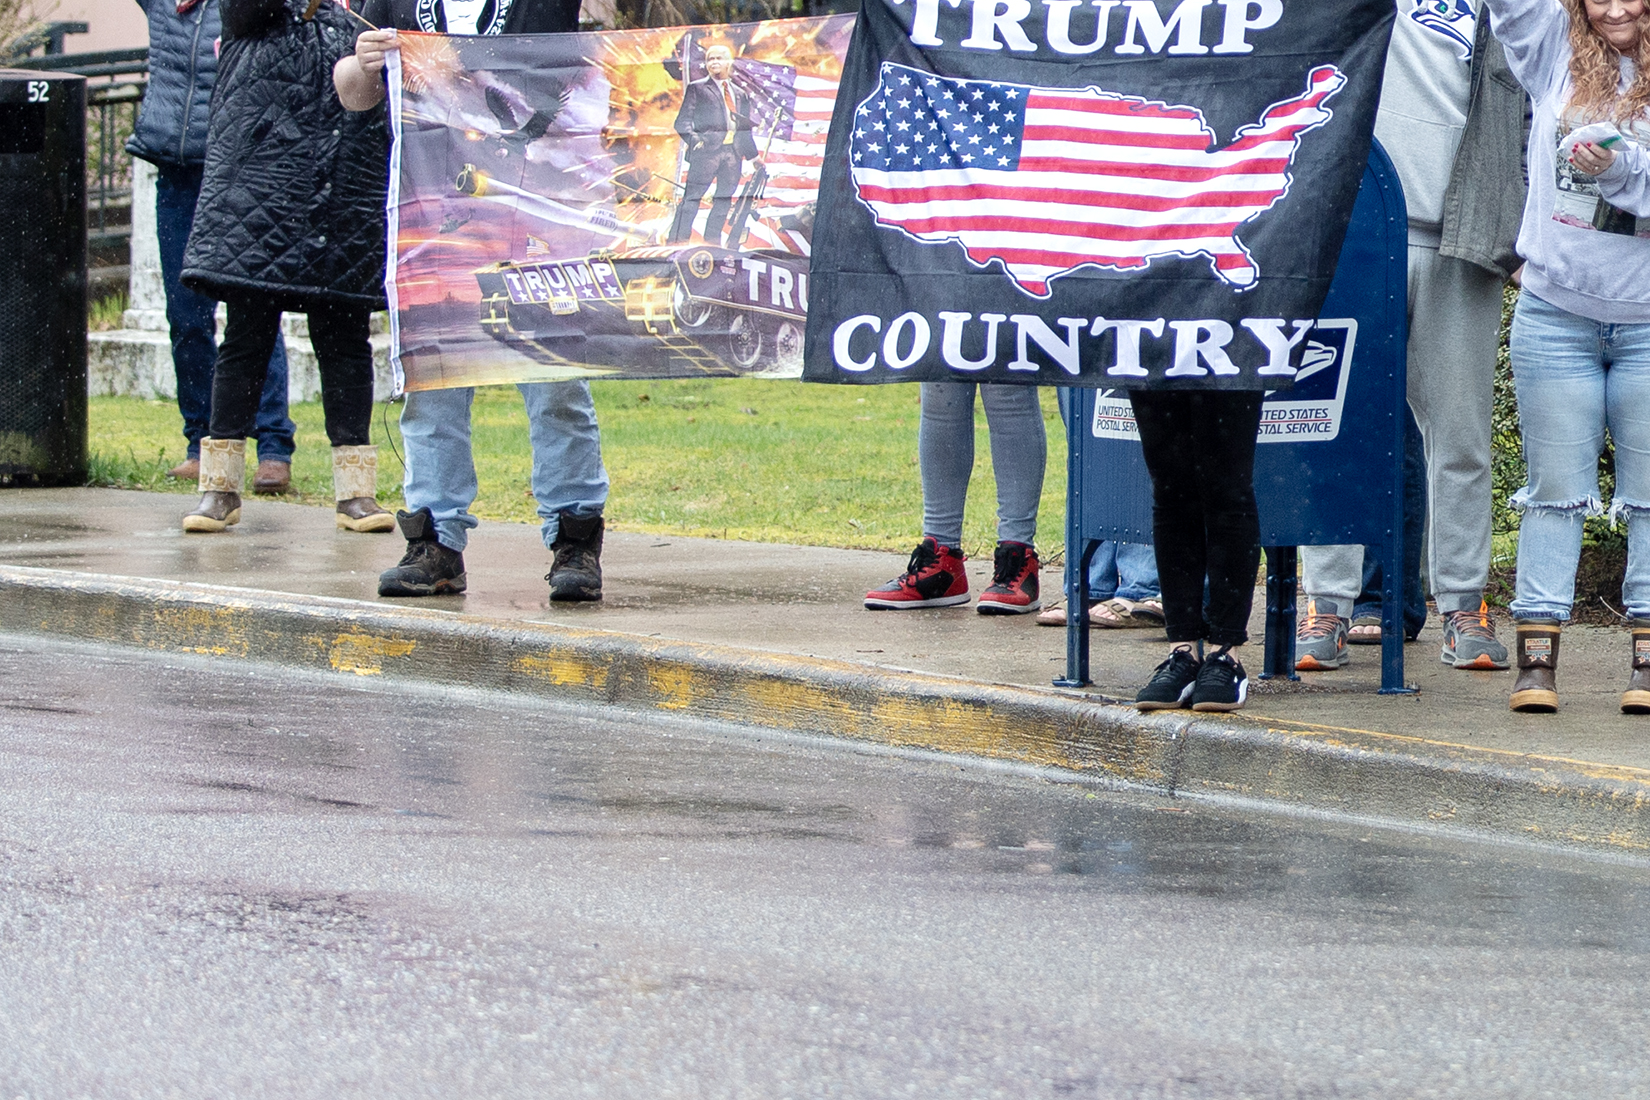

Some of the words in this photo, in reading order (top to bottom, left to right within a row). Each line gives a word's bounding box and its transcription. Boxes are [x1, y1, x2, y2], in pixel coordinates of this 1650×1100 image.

[28, 81, 50, 103] 52
[506, 264, 613, 291] TRUMP
[832, 310, 1316, 377] COUNTRY
[1098, 405, 1123, 417] UNITED
[1288, 408, 1329, 419] STATES
[1096, 419, 1120, 431] POSTAL
[1258, 423, 1283, 435] STAL
[1285, 422, 1332, 434] SERVICE
